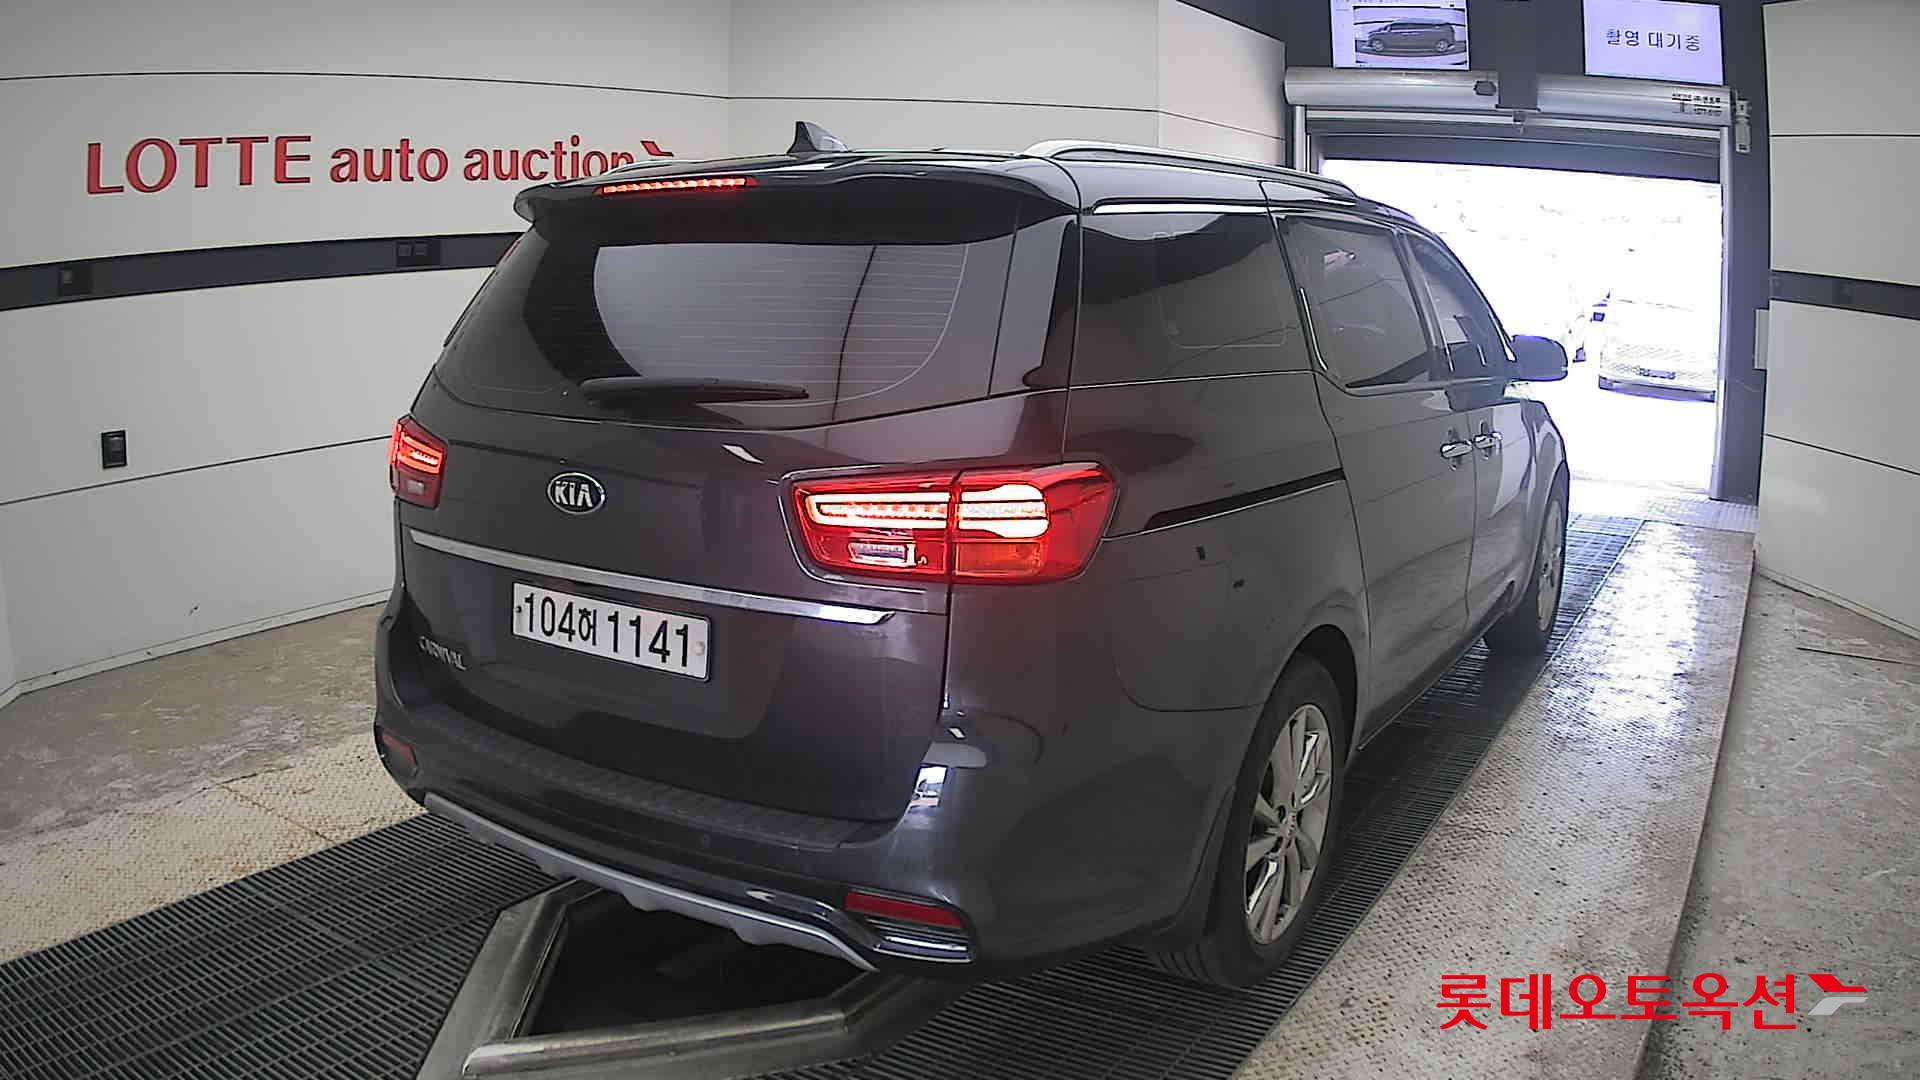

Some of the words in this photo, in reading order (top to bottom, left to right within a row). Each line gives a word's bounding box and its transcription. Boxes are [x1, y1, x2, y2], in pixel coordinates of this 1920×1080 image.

[1648, 31, 1701, 52] 대기중
[87, 135, 312, 195] LOTTE
[330, 138, 449, 183] auto
[555, 480, 593, 508] KIA
[607, 610, 690, 668] 1141
